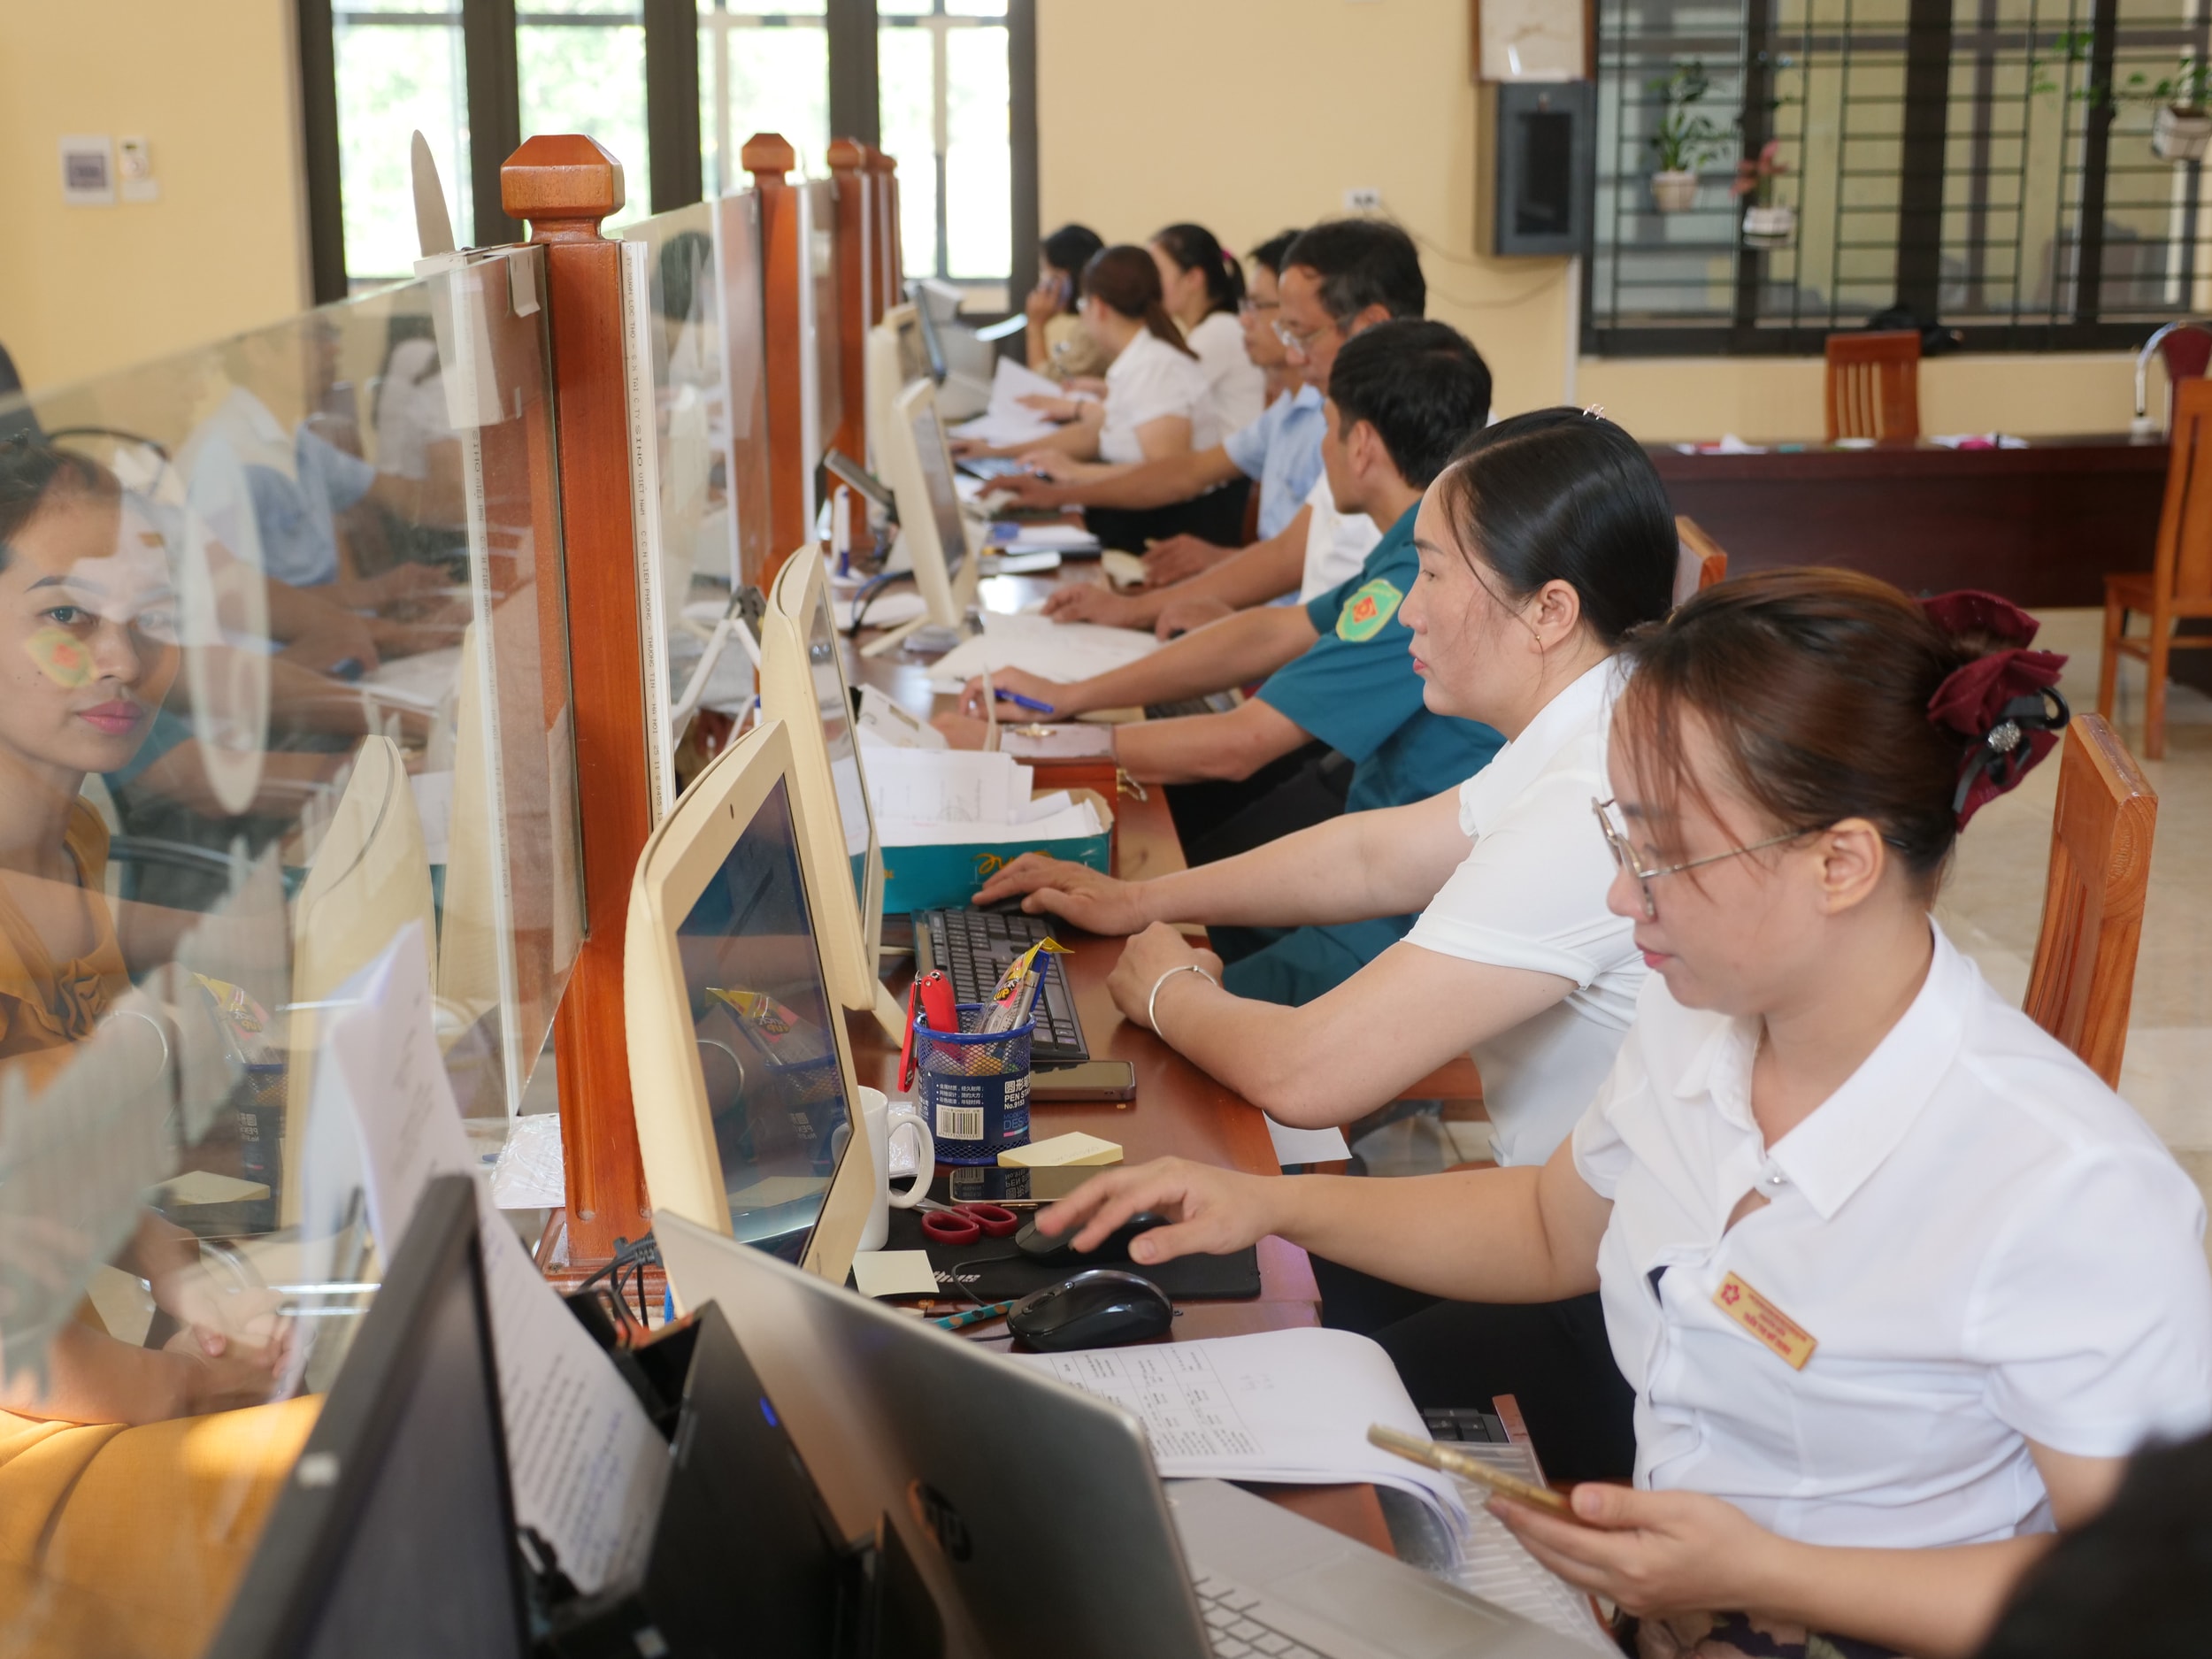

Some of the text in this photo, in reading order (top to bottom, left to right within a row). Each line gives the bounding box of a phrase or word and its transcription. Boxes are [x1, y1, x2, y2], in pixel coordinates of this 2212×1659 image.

[651, 703, 657, 714] HA
[1004, 1094, 1020, 1102] PEN
[1003, 1114, 1030, 1131] DESIG
